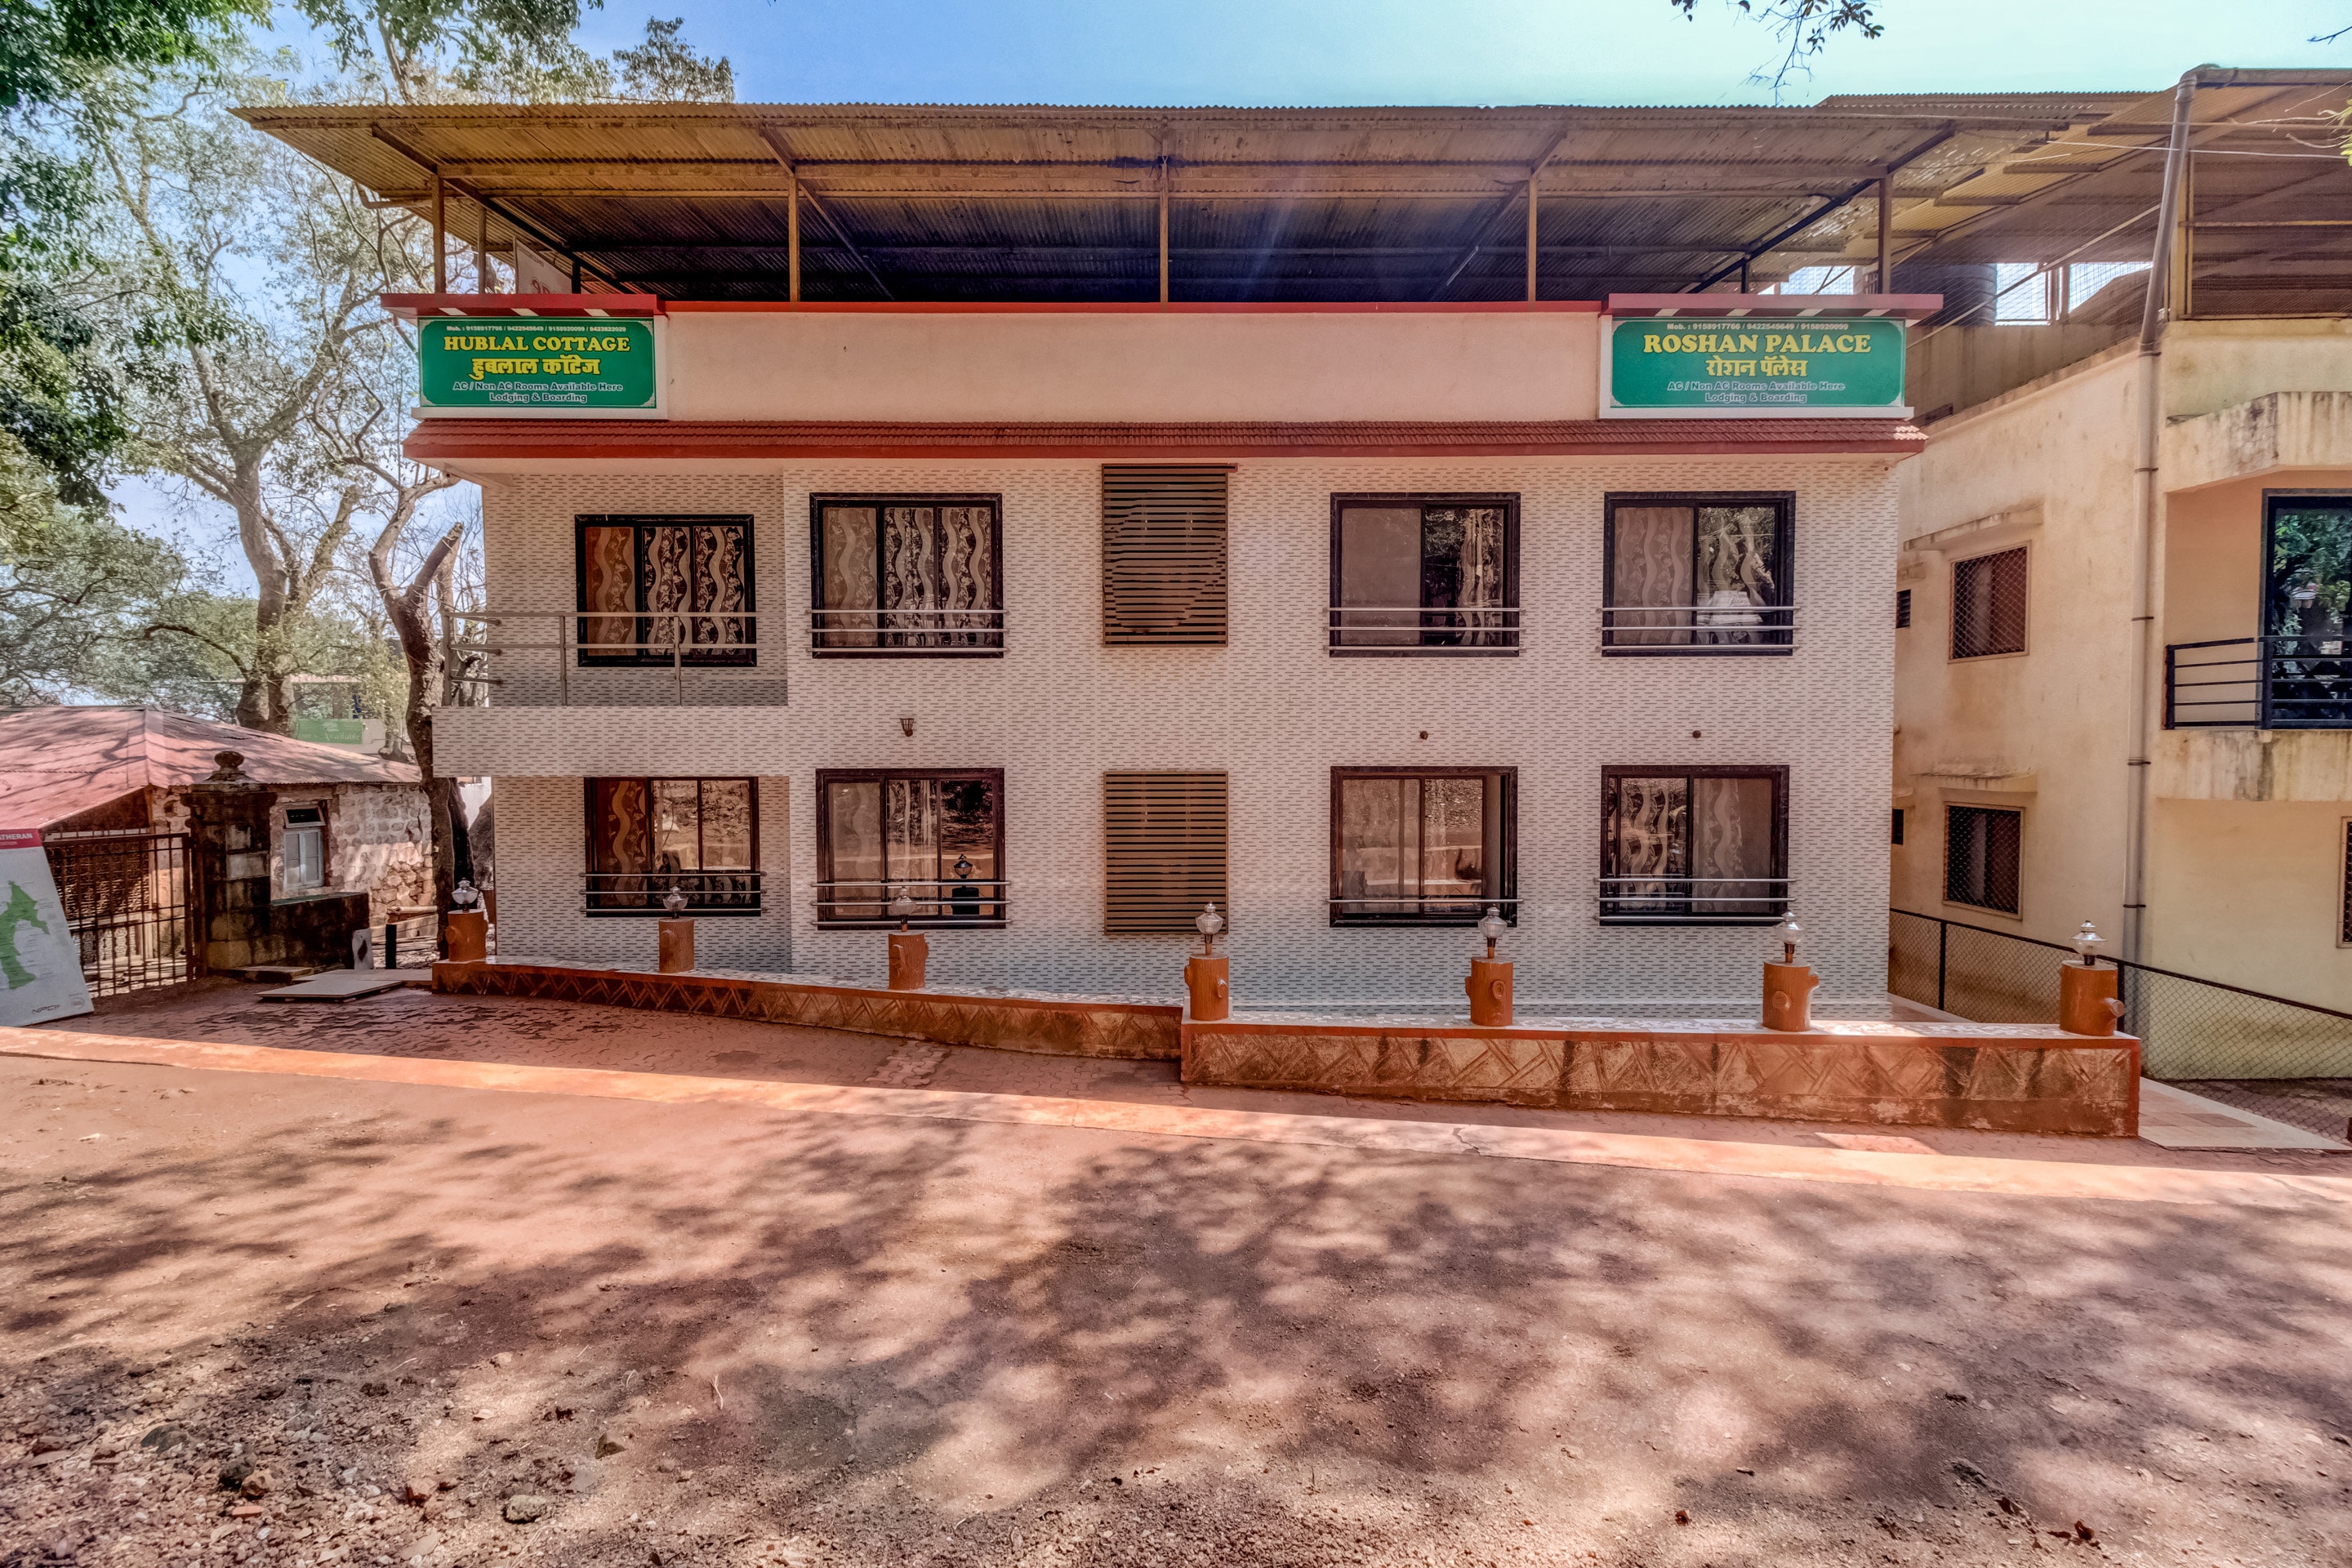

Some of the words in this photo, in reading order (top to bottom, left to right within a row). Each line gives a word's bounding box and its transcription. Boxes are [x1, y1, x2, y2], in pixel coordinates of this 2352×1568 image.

[443, 336, 529, 351] HUBLAL
[532, 336, 630, 351] COTTAGE
[1643, 333, 1759, 353] ROSHAN
[1765, 334, 1872, 353] PALACE
[468, 358, 539, 381] हुबलाल
[542, 354, 601, 375] कॉटेज
[1705, 354, 1757, 376] रोशन
[452, 381, 469, 391] AC
[475, 382, 497, 391] Non
[497, 381, 513, 391] AC
[514, 382, 549, 391] Rooms
[550, 381, 597, 391] Available
[598, 382, 623, 391] Here
[1667, 381, 1684, 391] AC
[1690, 381, 1713, 391] Non
[1713, 381, 1731, 391] AC
[1731, 381, 1767, 391] Rooms
[1767, 381, 1818, 391] Available
[1818, 381, 1846, 391] Here
[489, 392, 529, 403] Lodging
[531, 393, 541, 402] &
[542, 393, 587, 403] Boarding
[1705, 393, 1747, 403] Lodging
[1748, 393, 1758, 402] &
[1759, 393, 1807, 403] Boarding
